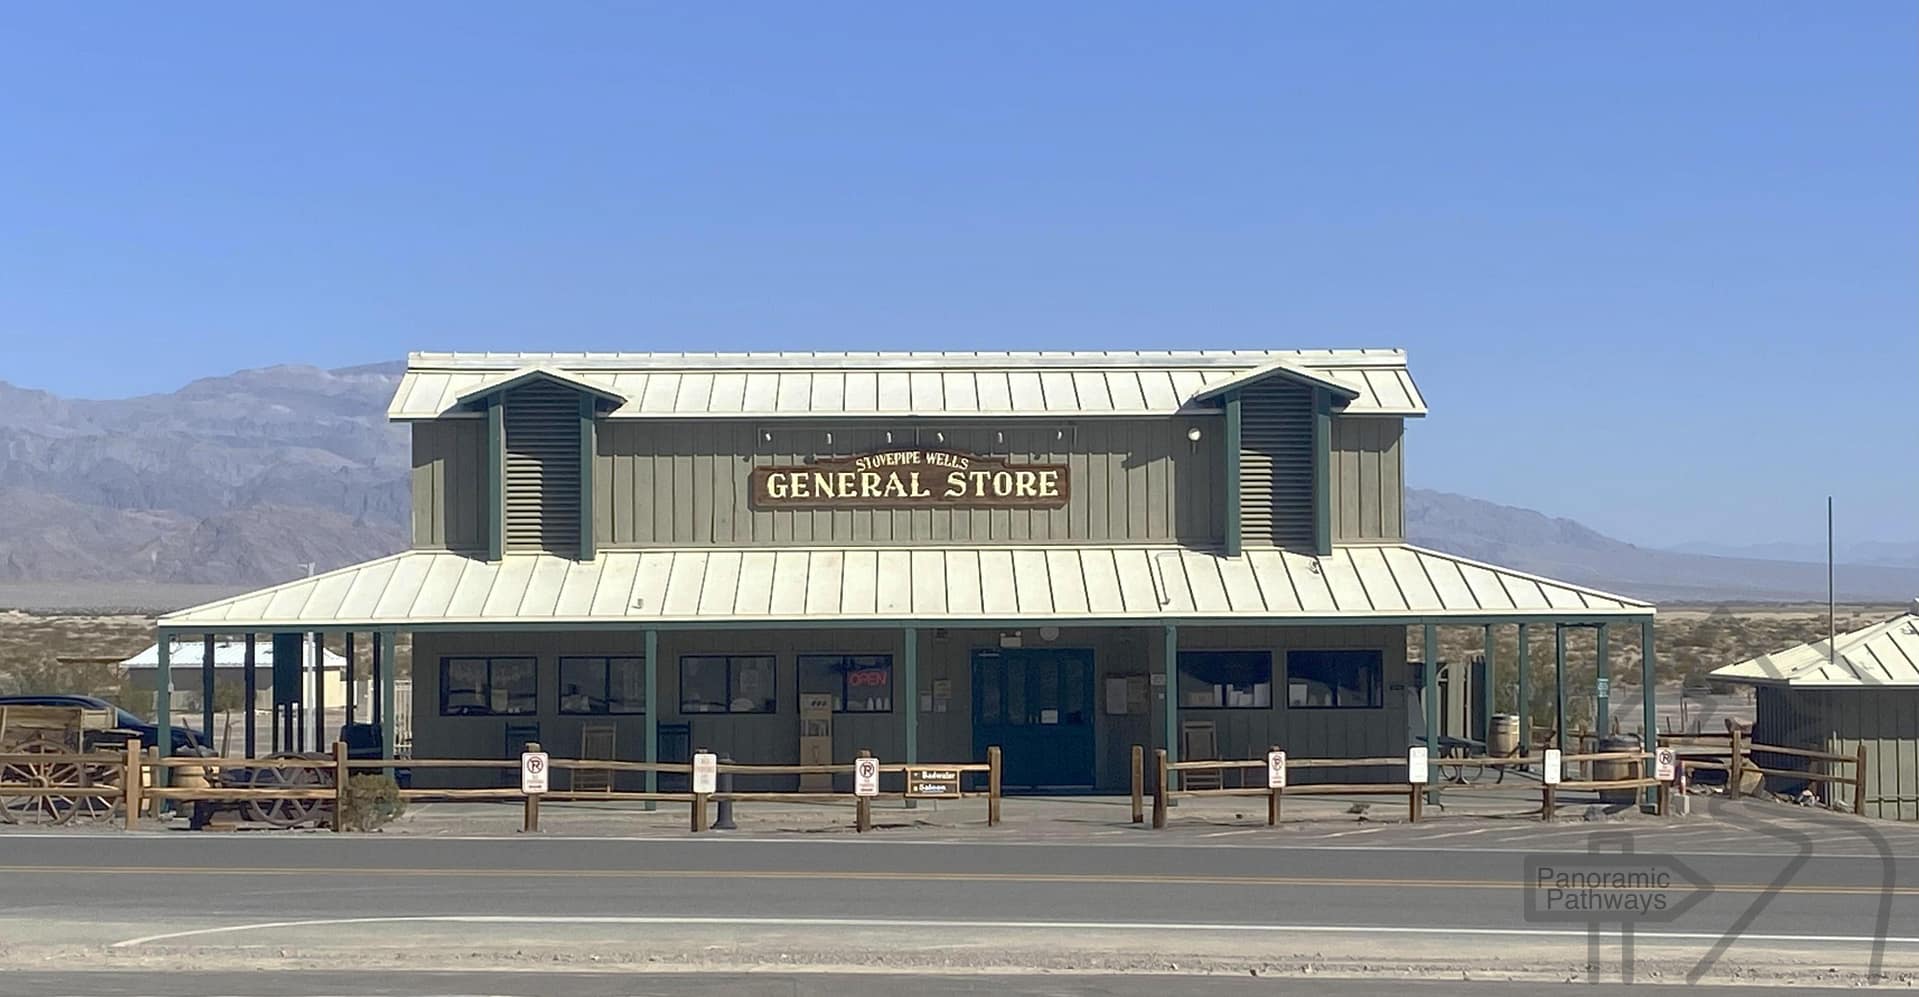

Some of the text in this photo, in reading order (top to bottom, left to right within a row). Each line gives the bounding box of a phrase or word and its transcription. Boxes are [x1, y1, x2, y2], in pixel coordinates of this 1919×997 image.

[855, 451, 969, 472] STOVEPIPE WELLS
[766, 470, 1058, 498] GENERAL STORE
[850, 671, 887, 686] OPEN
